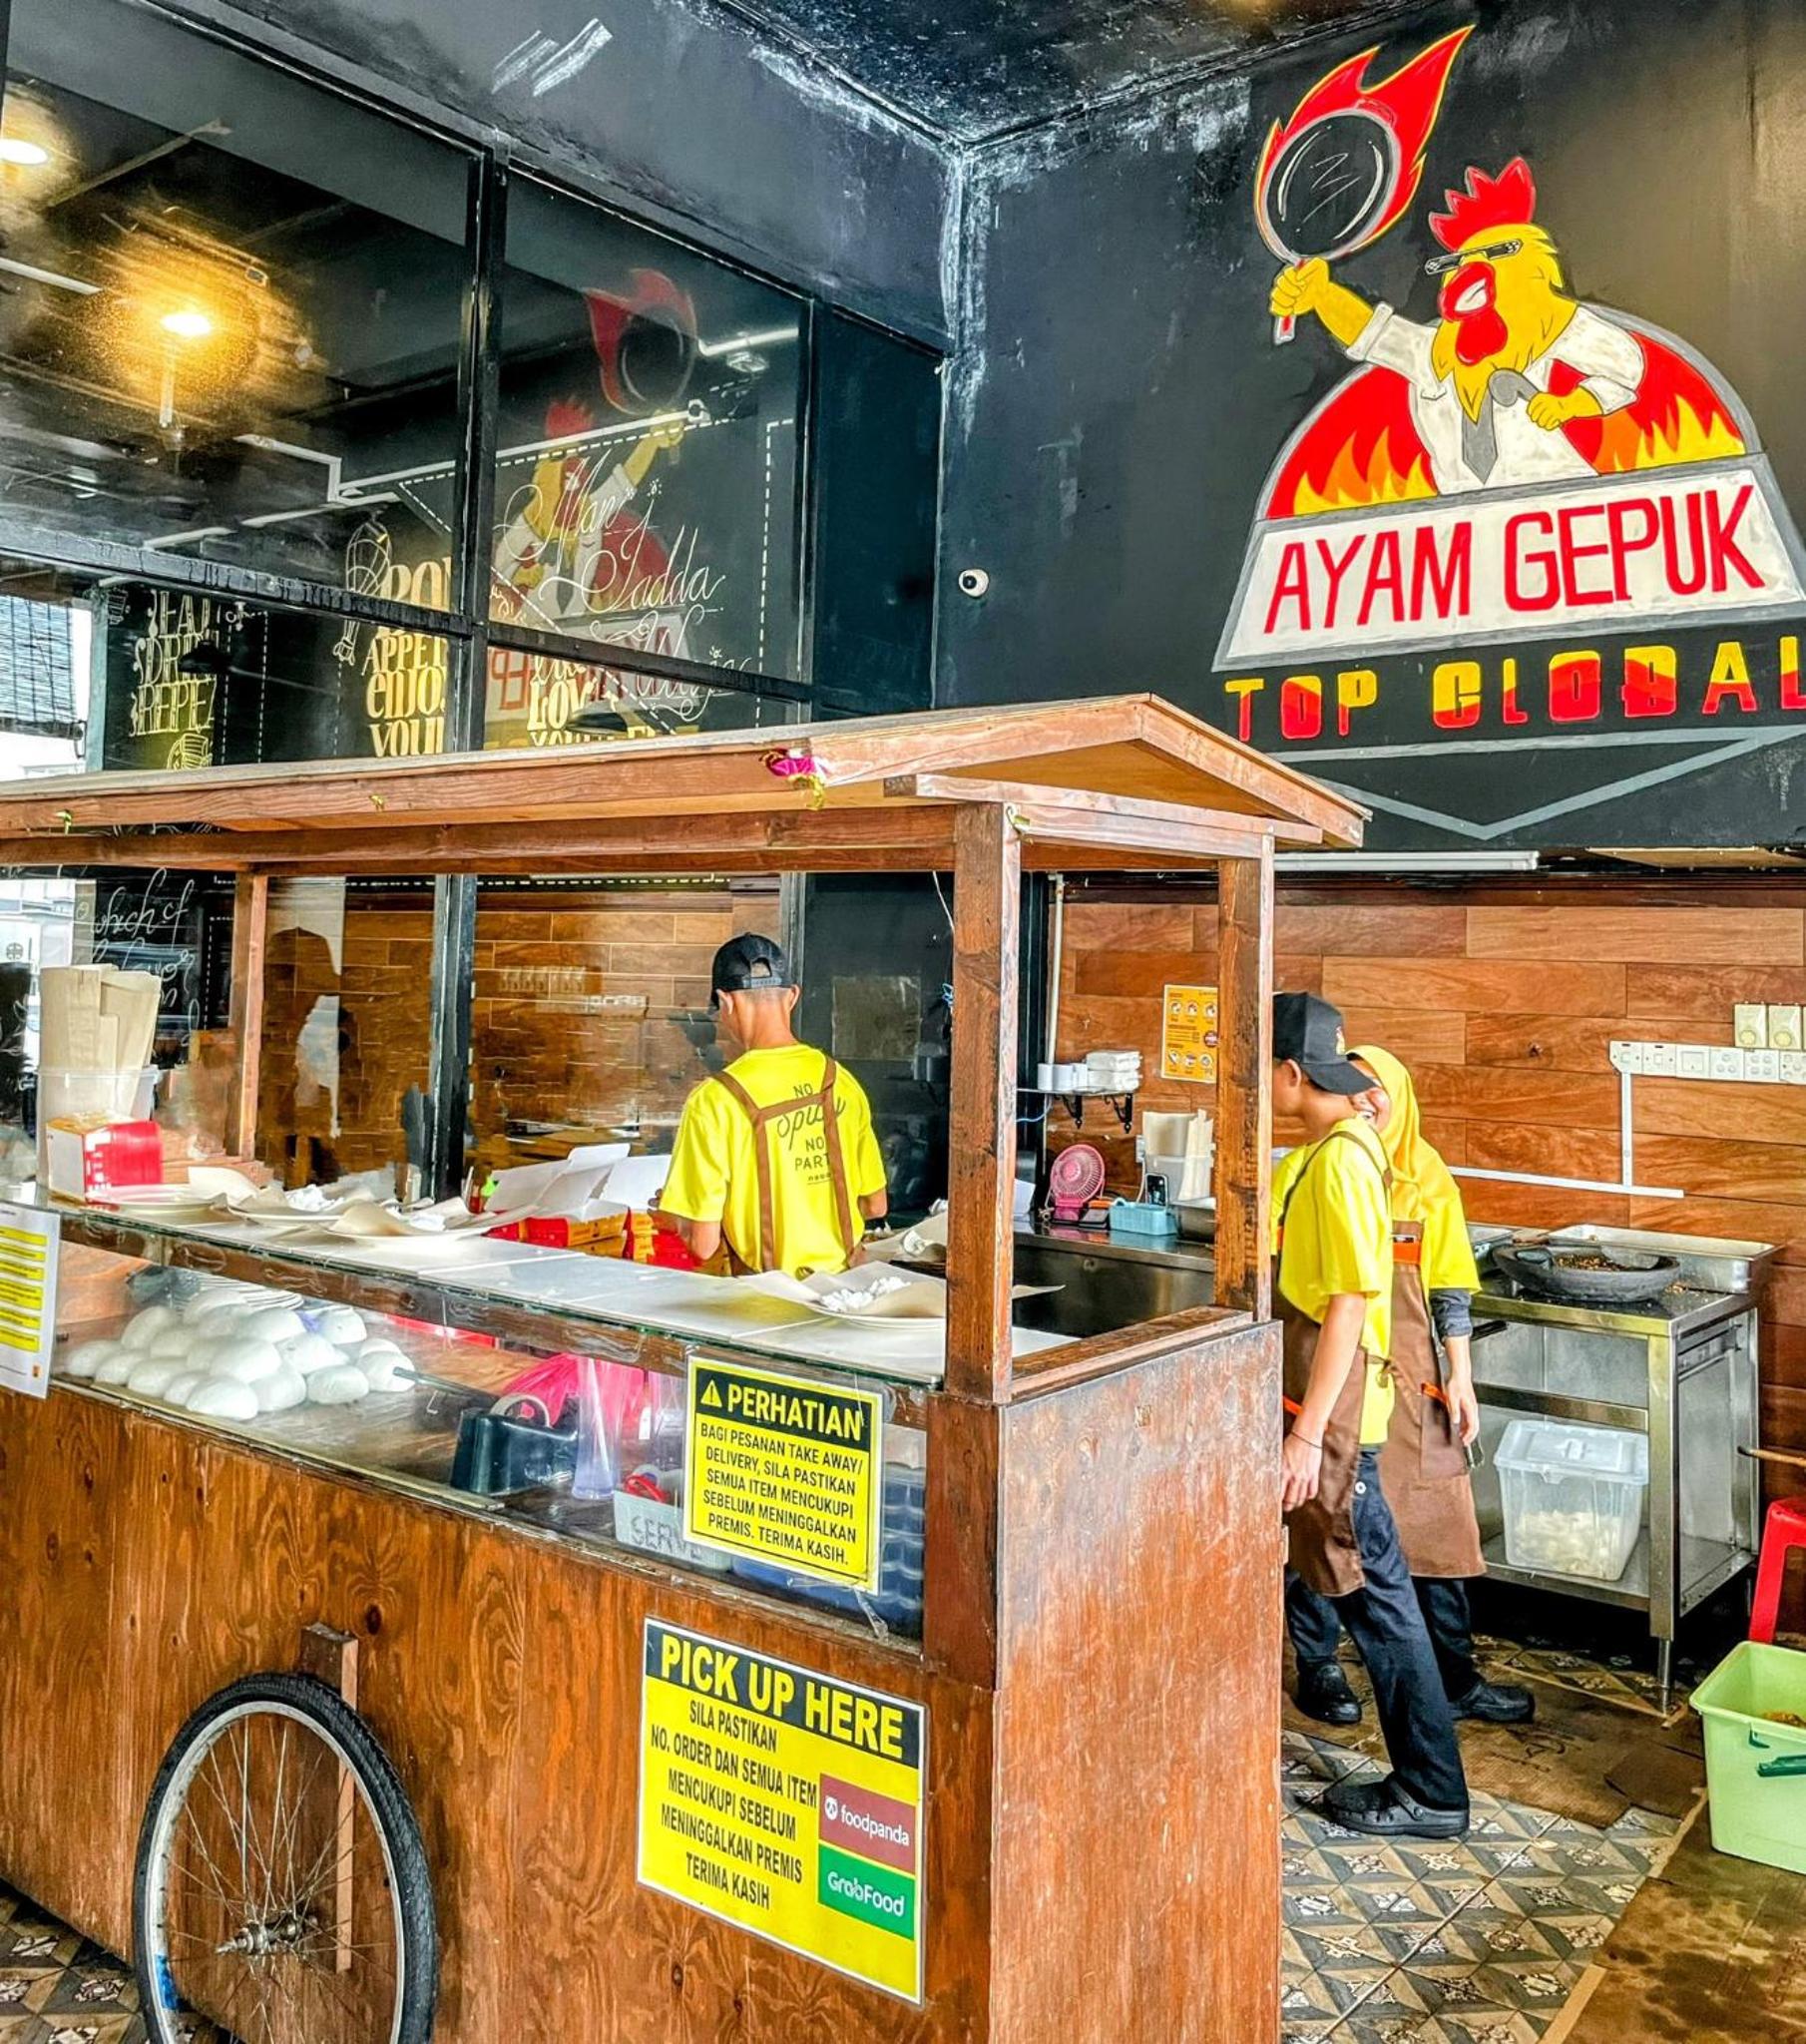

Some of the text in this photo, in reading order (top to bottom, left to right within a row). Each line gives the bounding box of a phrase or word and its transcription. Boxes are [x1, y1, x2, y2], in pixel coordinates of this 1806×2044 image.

[1264, 485, 1766, 633] AYAM GEPUK
[1224, 636, 1806, 742] TOP GLOBAL
[793, 1083, 813, 1097] NO
[794, 1153, 831, 1172] PART
[805, 1136, 825, 1152] NO
[727, 1383, 862, 1441] PERHATIAN
[700, 1422, 863, 1475] BAGI PESANAN TAKE AWAY/
[705, 1446, 856, 1496] DELIVERY, SILA PASTIKAN
[703, 1489, 856, 1544] SEBELUM MENINGGALKAN
[706, 1468, 854, 1519] SEMUA ITEM MENCUKUPI
[708, 1512, 848, 1565] PREMIS. TERIMA KASIH.
[662, 1634, 903, 1759] PICK UP HERE
[689, 1700, 777, 1754] SILA PASTIKAN
[652, 1725, 817, 1808] NO. ORDER DAN SEMUA ITEM
[669, 1768, 796, 1841] MENCUKUPI SEBELUM
[841, 1803, 910, 1846] foodpanda
[662, 1802, 802, 1884] MENINGGALKAN PREMIS
[686, 1851, 769, 1910] TERIMA KASIH
[827, 1871, 905, 1917] GrabFood
